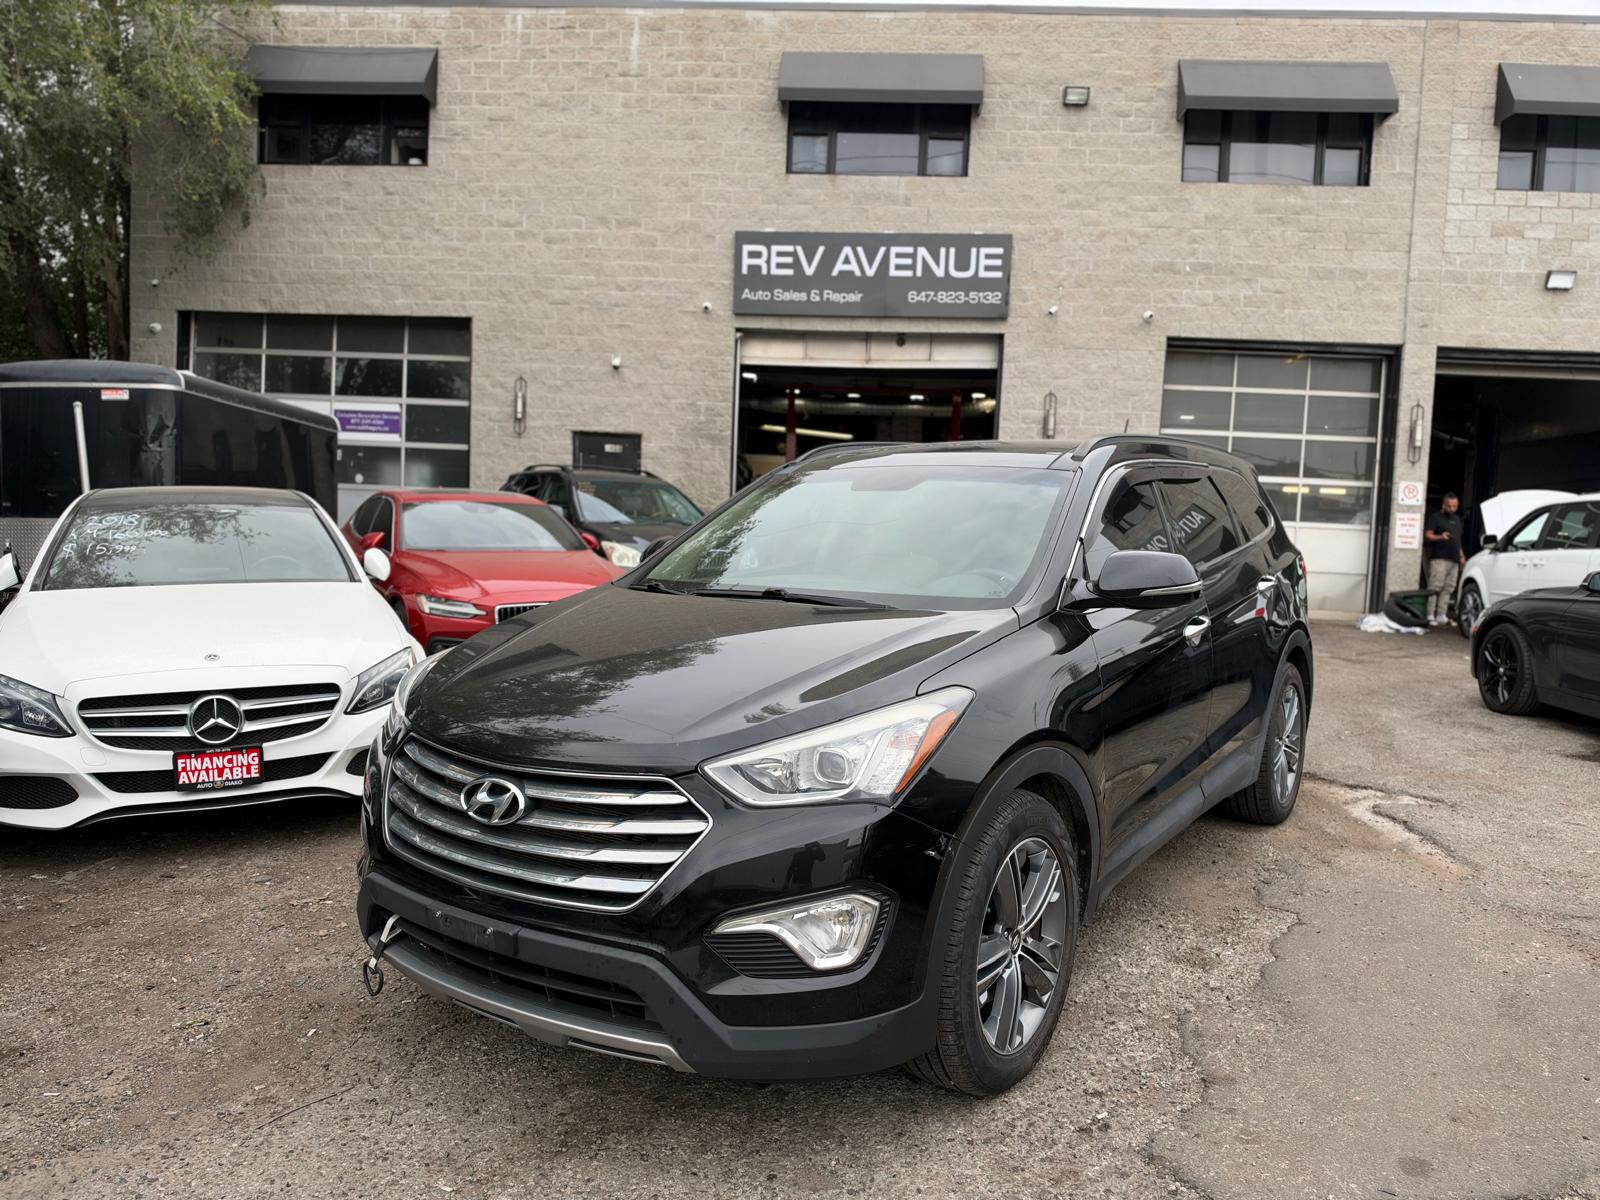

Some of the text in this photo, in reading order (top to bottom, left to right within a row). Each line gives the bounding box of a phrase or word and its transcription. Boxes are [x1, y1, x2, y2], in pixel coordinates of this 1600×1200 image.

[741, 244, 1004, 278] REV AVENUE
[741, 288, 863, 304] Auto Sales & Repair
[908, 290, 1002, 304] 647-823-5132
[177, 752, 259, 772] FINANCING
[178, 765, 260, 784] AVAILABLE
